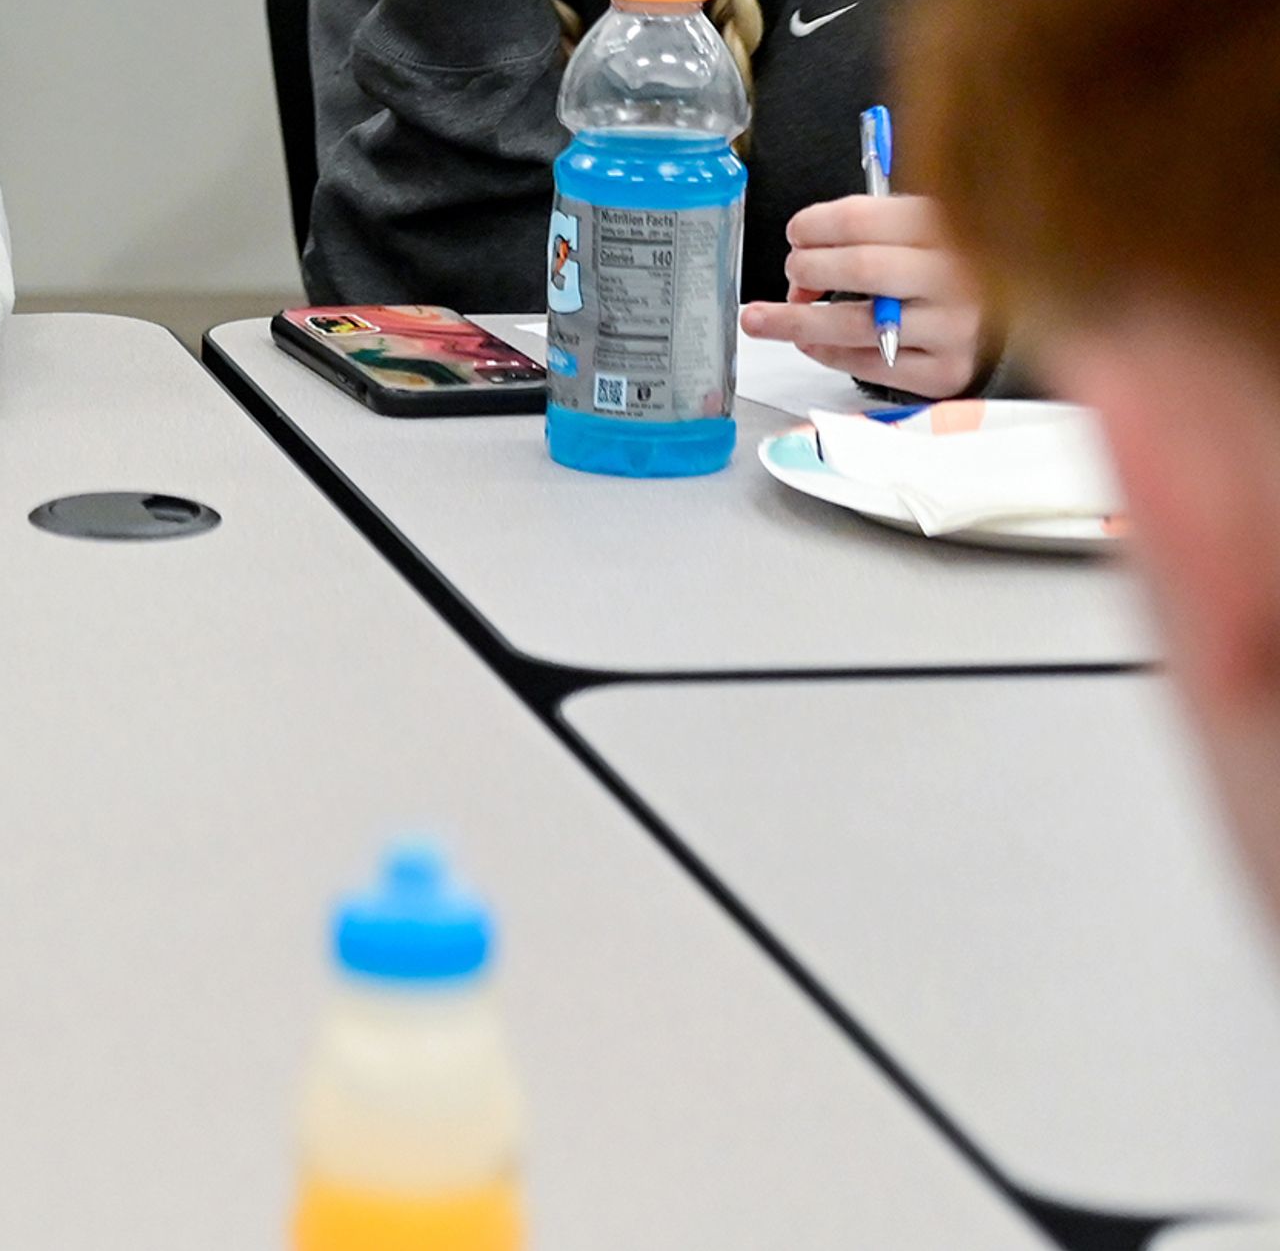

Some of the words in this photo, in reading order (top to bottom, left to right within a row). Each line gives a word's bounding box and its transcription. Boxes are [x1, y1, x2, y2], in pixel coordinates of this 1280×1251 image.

[601, 210, 644, 226] Nutrition
[646, 213, 674, 228] Facts
[600, 249, 635, 265] Calories
[652, 250, 673, 266] 140
